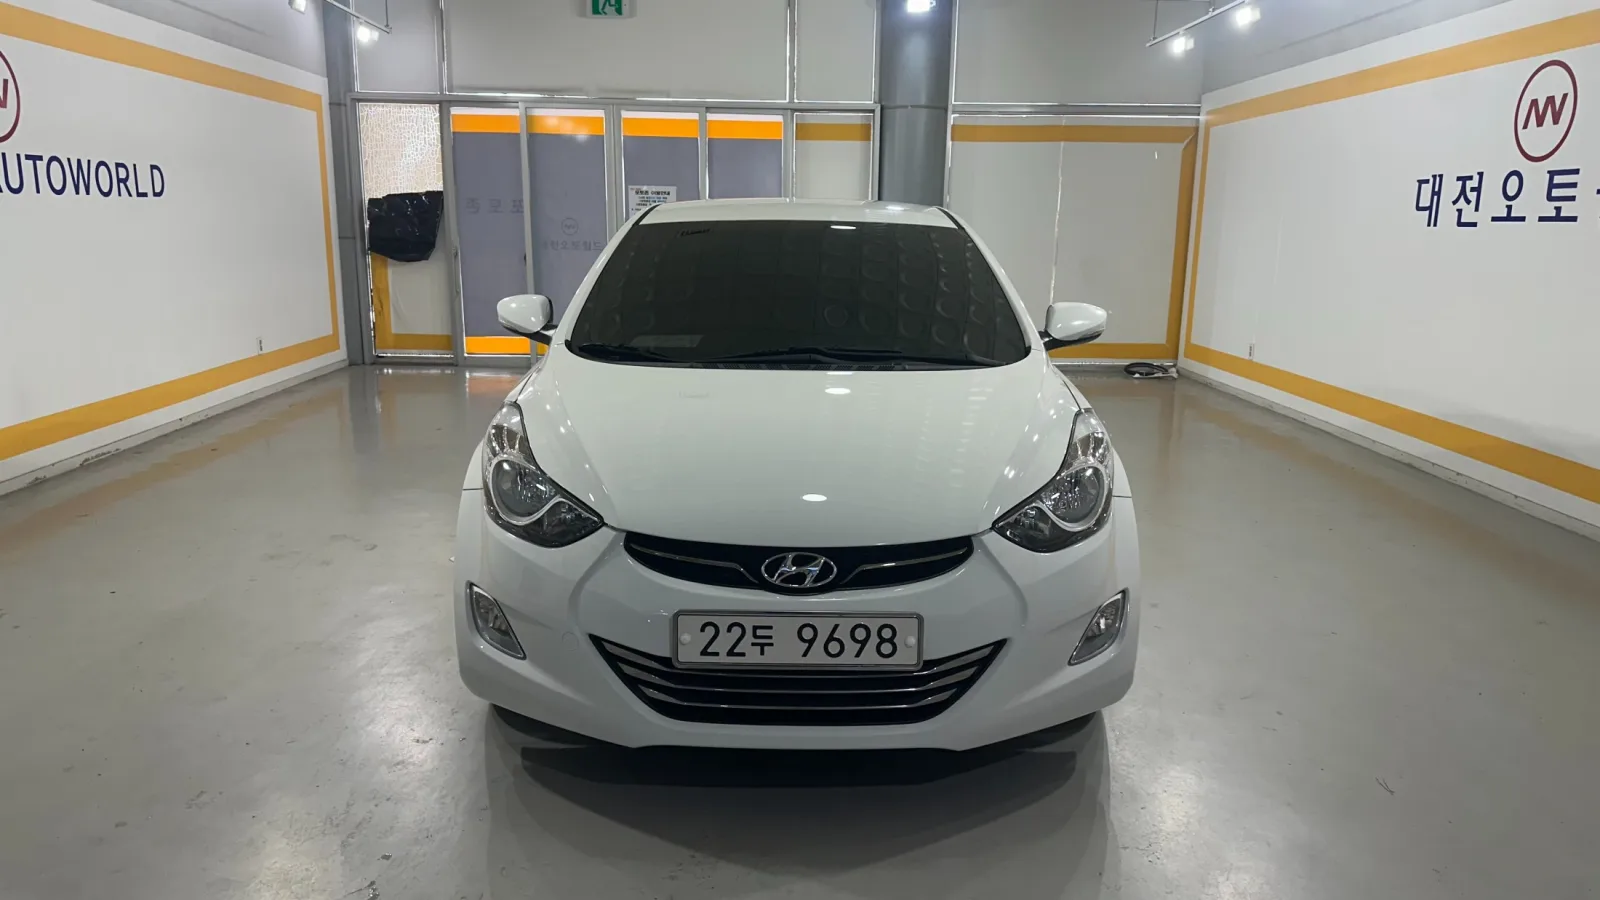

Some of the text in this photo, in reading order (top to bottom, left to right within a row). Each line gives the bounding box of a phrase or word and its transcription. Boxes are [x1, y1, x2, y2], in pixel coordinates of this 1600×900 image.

[0, 152, 165, 198] UTOWORLD
[1415, 168, 1600, 227] 대전오토
[700, 621, 898, 658] 22두 9698
